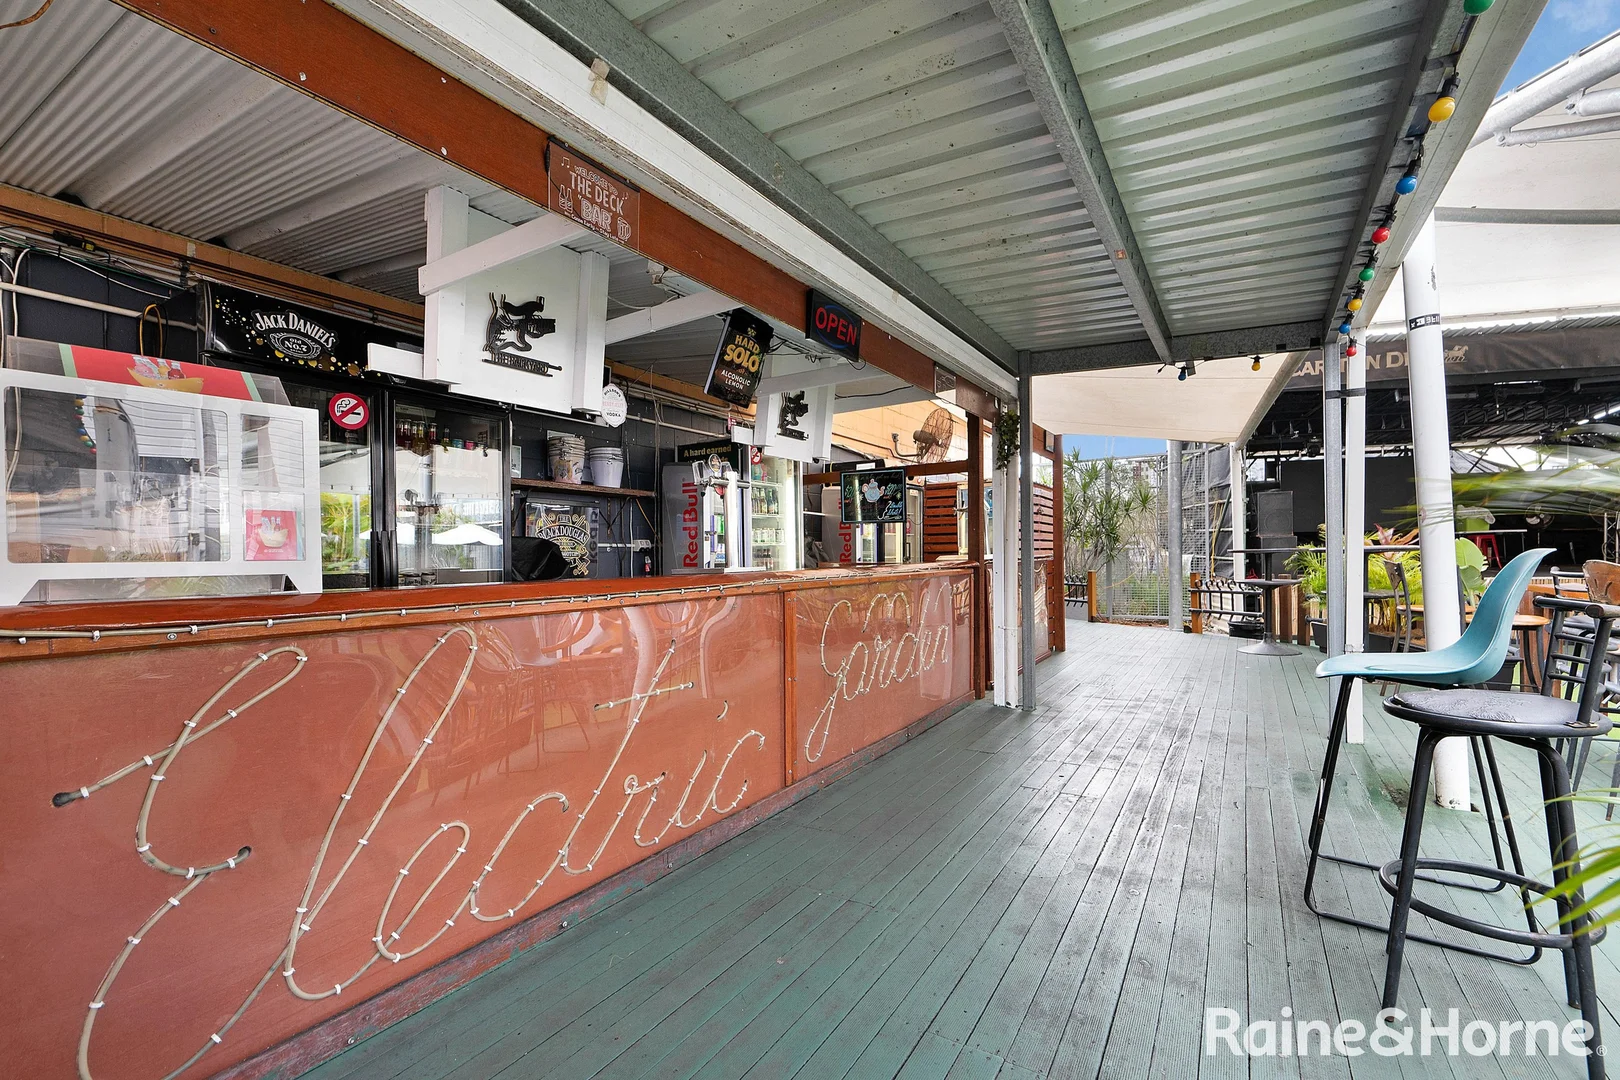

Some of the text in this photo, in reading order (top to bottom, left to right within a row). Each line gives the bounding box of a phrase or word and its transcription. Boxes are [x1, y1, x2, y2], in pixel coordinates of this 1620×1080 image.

[569, 171, 624, 215] THE DECK
[581, 198, 612, 232] BAR
[255, 312, 336, 348] JACK DANIEL'S
[815, 306, 858, 346] OPEN
[723, 344, 760, 373] SOLO
[734, 334, 760, 354] HARD
[721, 369, 751, 386] ALCOHOLIC
[725, 378, 744, 390] LEMON
[690, 447, 706, 456] hard
[706, 444, 732, 455] earned
[560, 525, 588, 545] DOUGLAS
[682, 482, 698, 567] Red Bull
[838, 532, 852, 563] Red
[49, 625, 766, 1080] Electric
